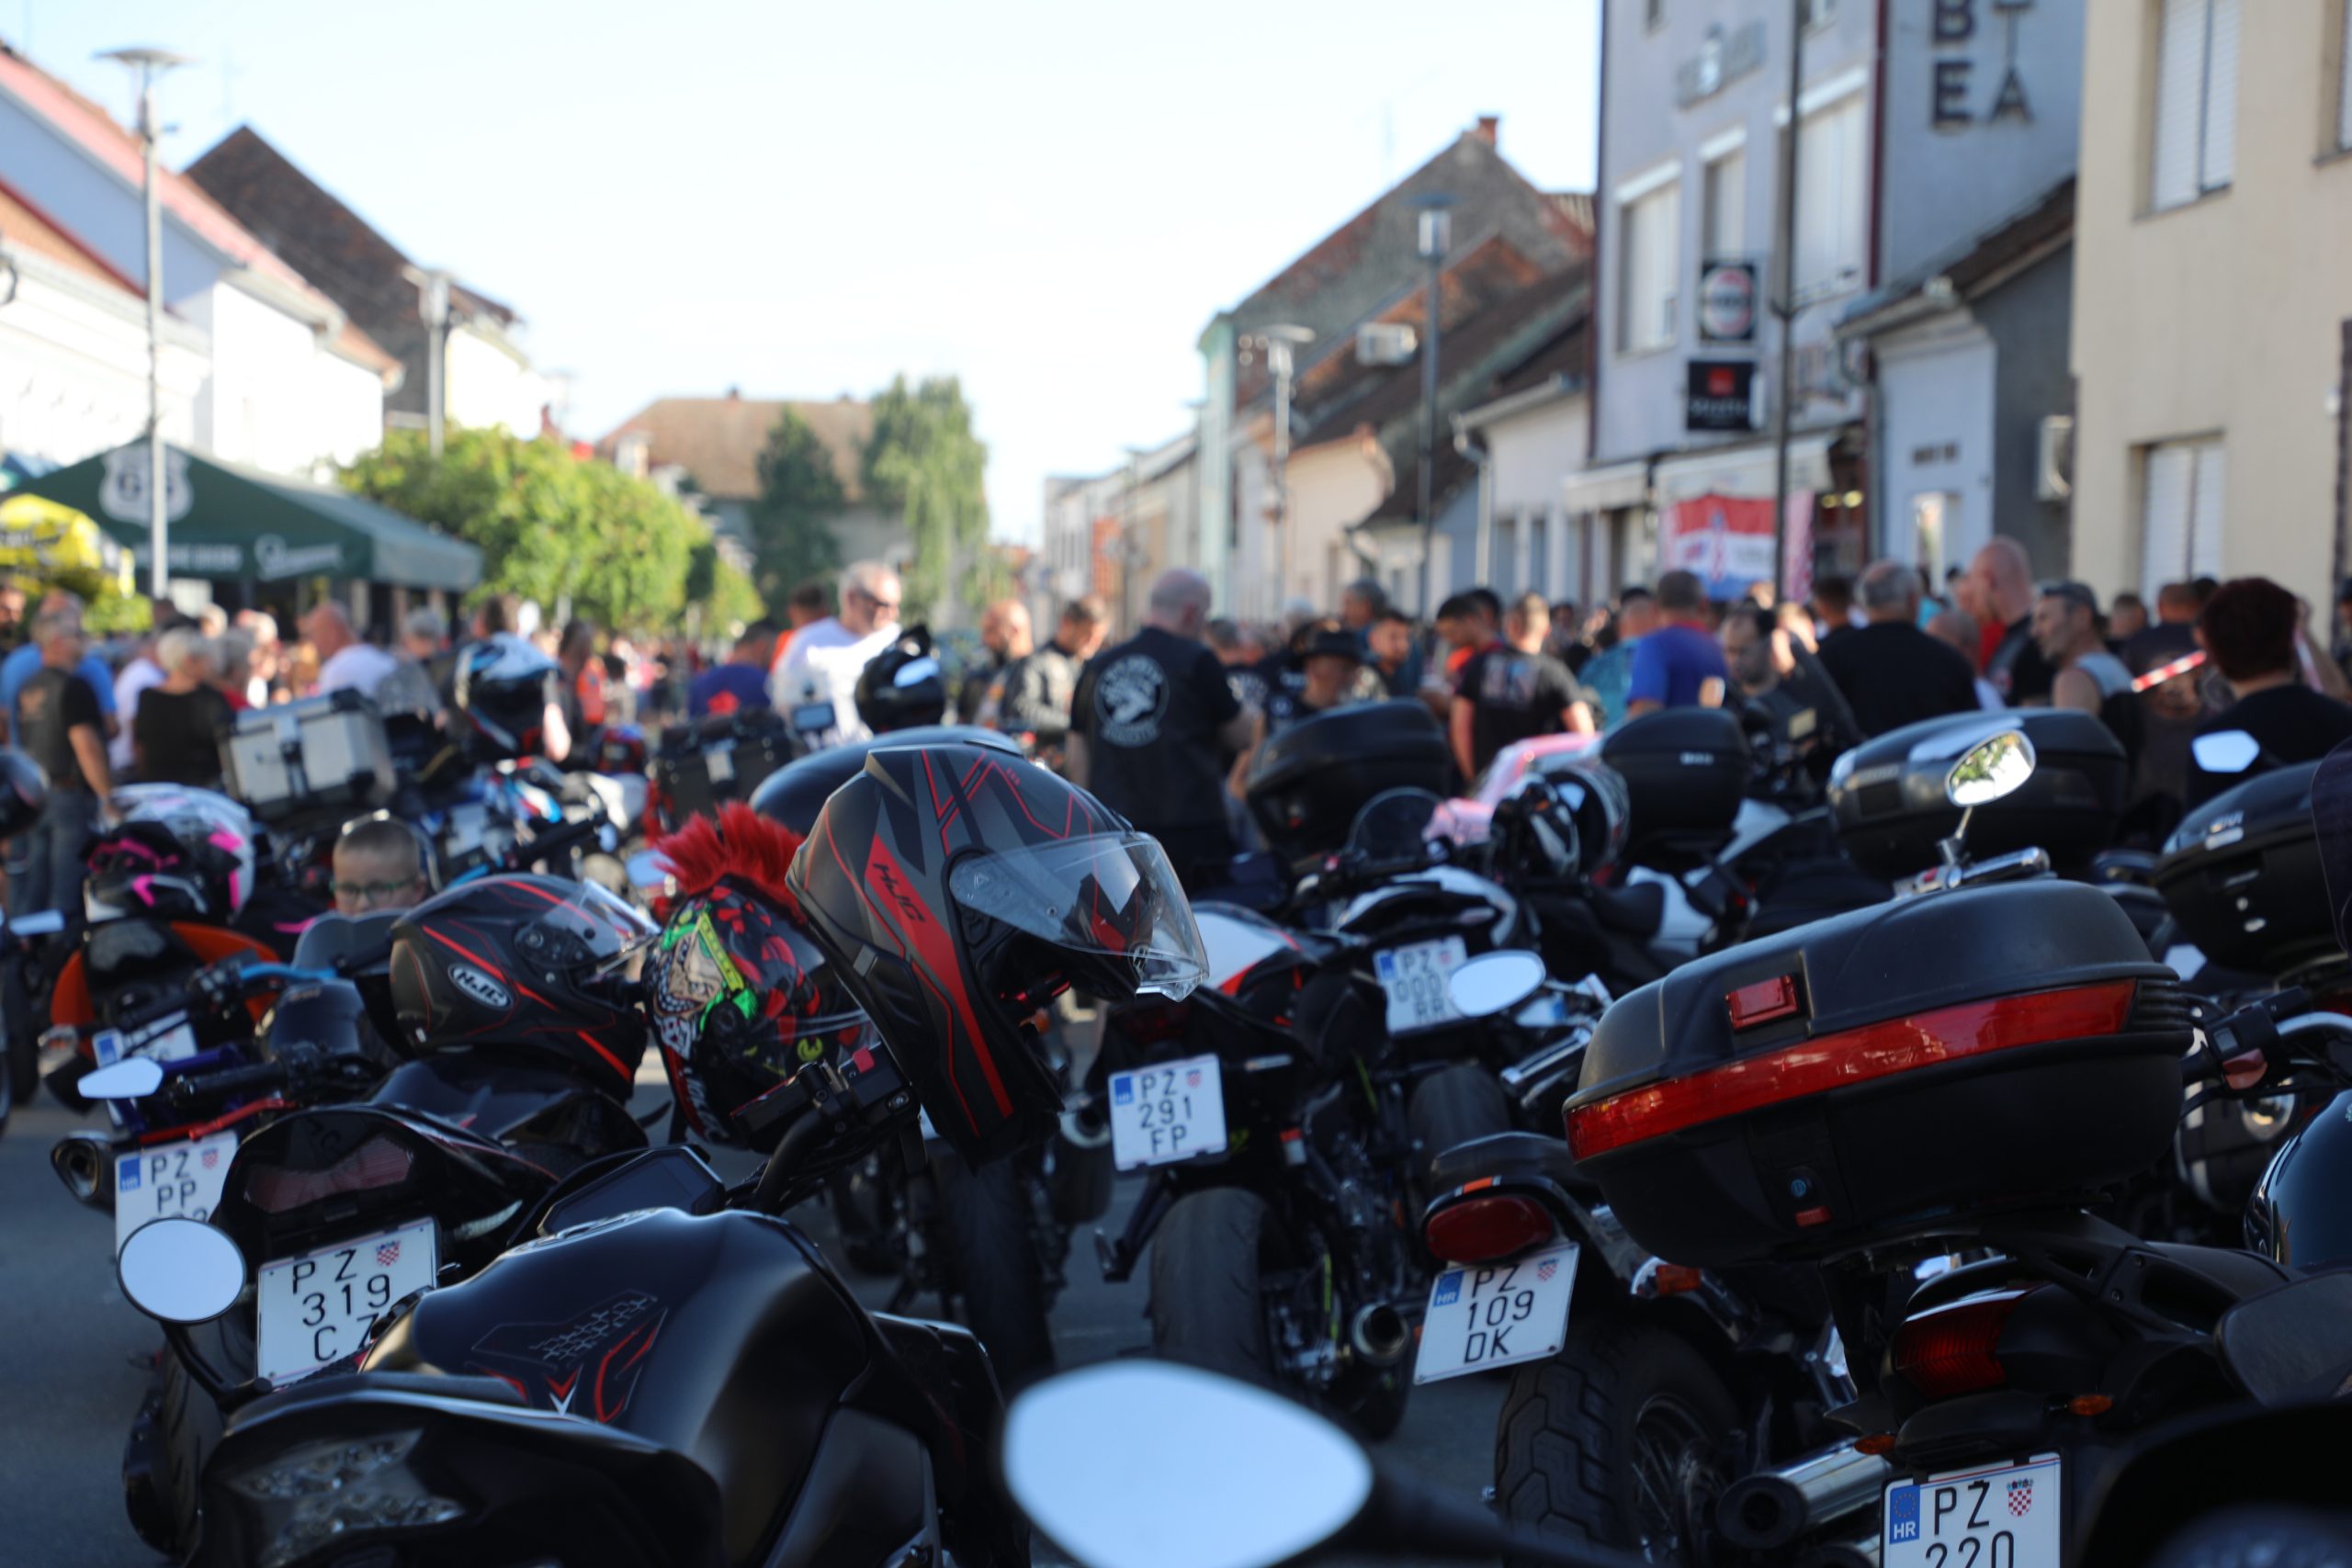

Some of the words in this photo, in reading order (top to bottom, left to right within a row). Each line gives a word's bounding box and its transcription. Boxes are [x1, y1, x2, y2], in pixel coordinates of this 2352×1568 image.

[1137, 1096, 1192, 1129] 291
[1150, 1124, 1186, 1155] FP
[157, 1180, 197, 1213] PP
[302, 1274, 390, 1326] 319
[1436, 1292, 1457, 1304] HR
[1468, 1290, 1534, 1331] 109
[1464, 1325, 1514, 1364] DK
[1894, 1521, 1917, 1540] HR
[1926, 1530, 2015, 1568] 220
